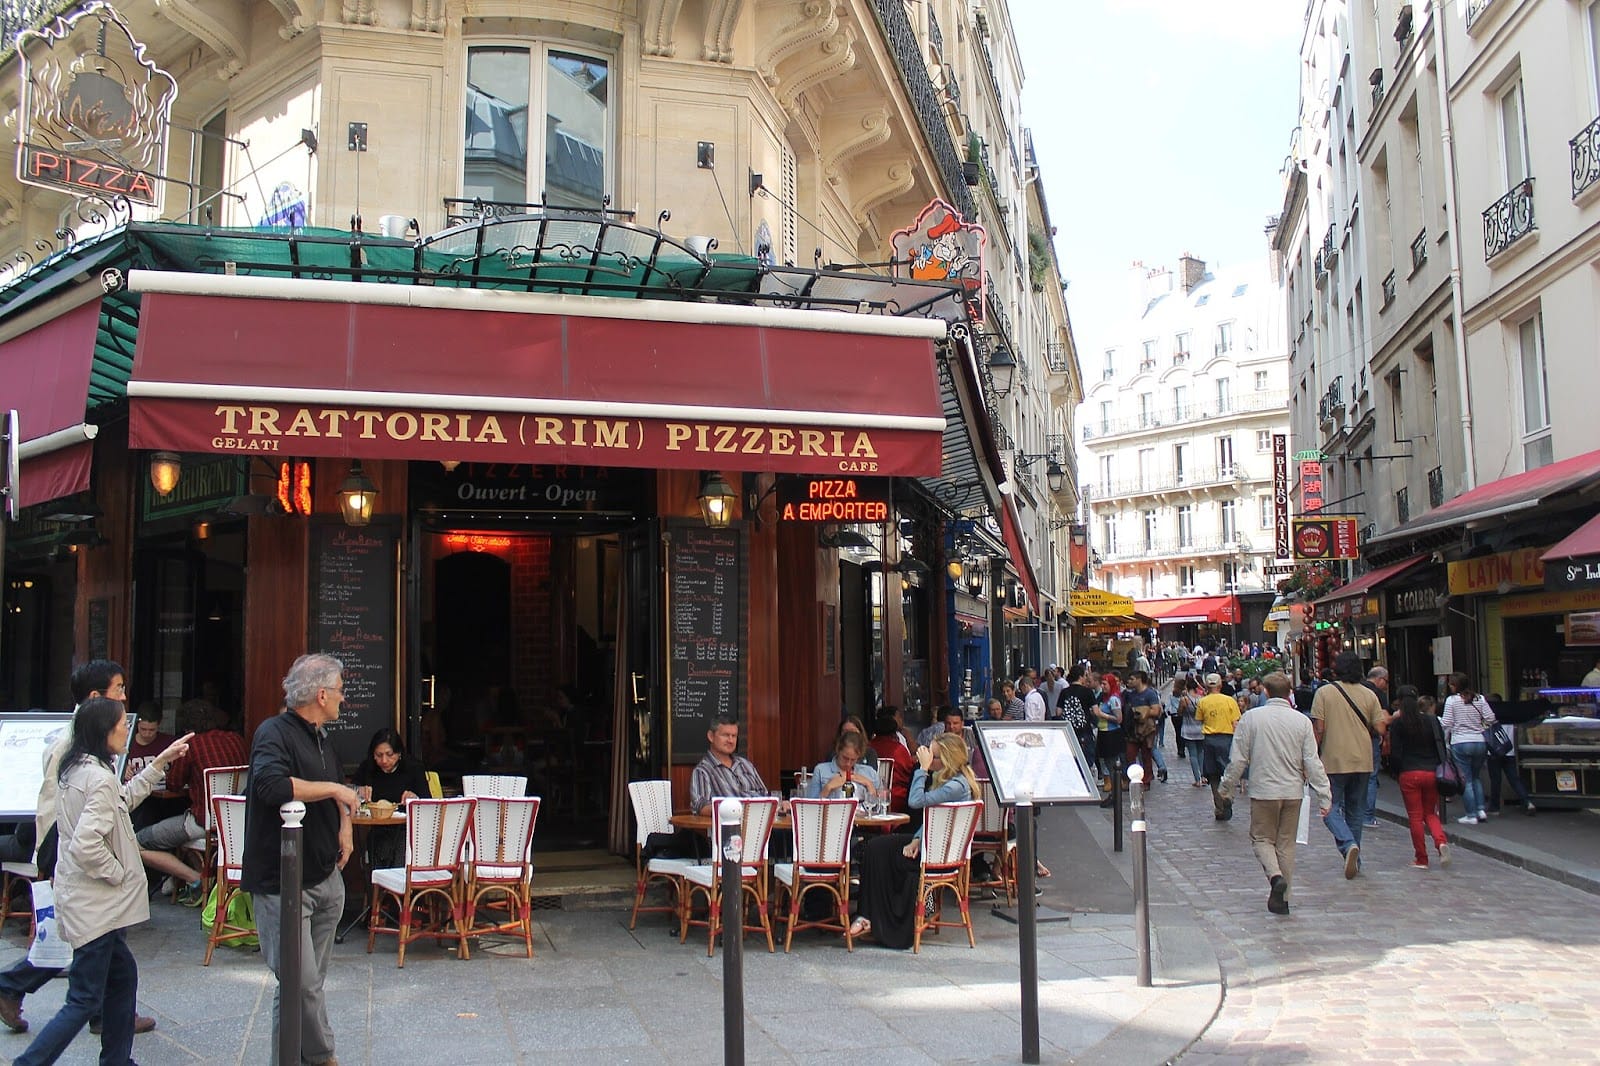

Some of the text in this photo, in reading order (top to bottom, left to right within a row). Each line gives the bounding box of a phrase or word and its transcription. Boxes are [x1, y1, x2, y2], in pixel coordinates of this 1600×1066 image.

[33, 152, 154, 198] PIZZA
[215, 405, 879, 458] TRATTORIA (RIM) PIZZERIA
[212, 437, 279, 451] GELATI
[443, 462, 609, 479] IZZERIA
[839, 461, 879, 472] CAFE
[457, 482, 527, 501] Ouvert
[545, 484, 598, 506] Open
[809, 479, 856, 499] PIZZA
[1275, 436, 1289, 556] EL BISTRO LATINO
[783, 502, 888, 521] A EMPORTER
[1266, 565, 1298, 575] PAELLA
[1466, 553, 1513, 588] LATIN
